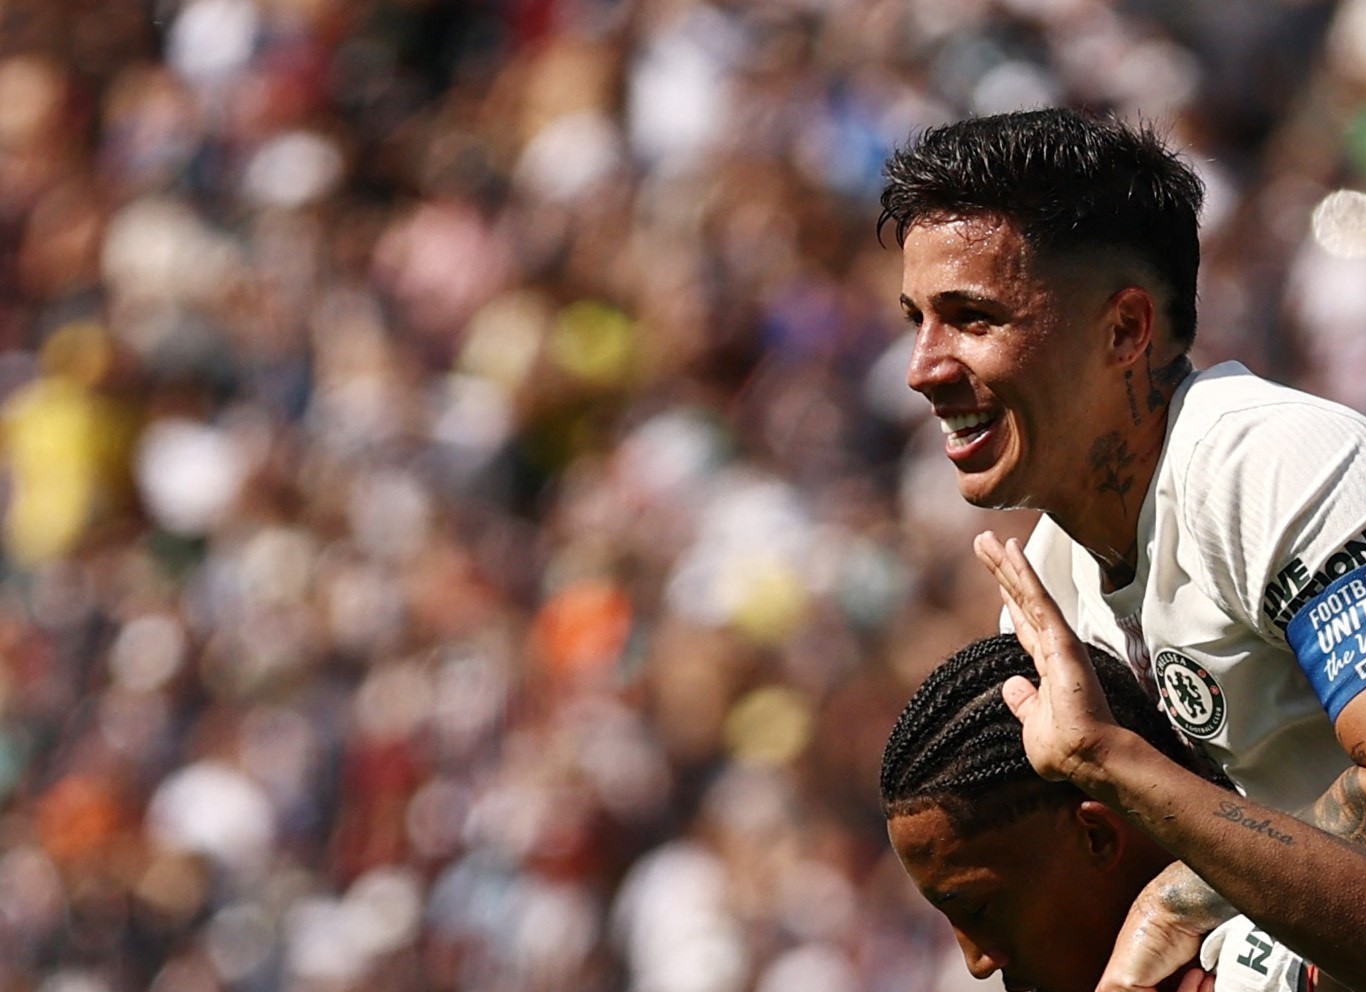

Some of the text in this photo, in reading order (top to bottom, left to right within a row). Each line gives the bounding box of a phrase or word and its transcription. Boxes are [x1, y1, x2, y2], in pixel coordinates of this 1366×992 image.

[1263, 557, 1310, 620] LIVE
[1156, 652, 1187, 677] CHELSEA
[1323, 650, 1355, 681] the
[1184, 706, 1222, 734] FOOTBALL CLUB
